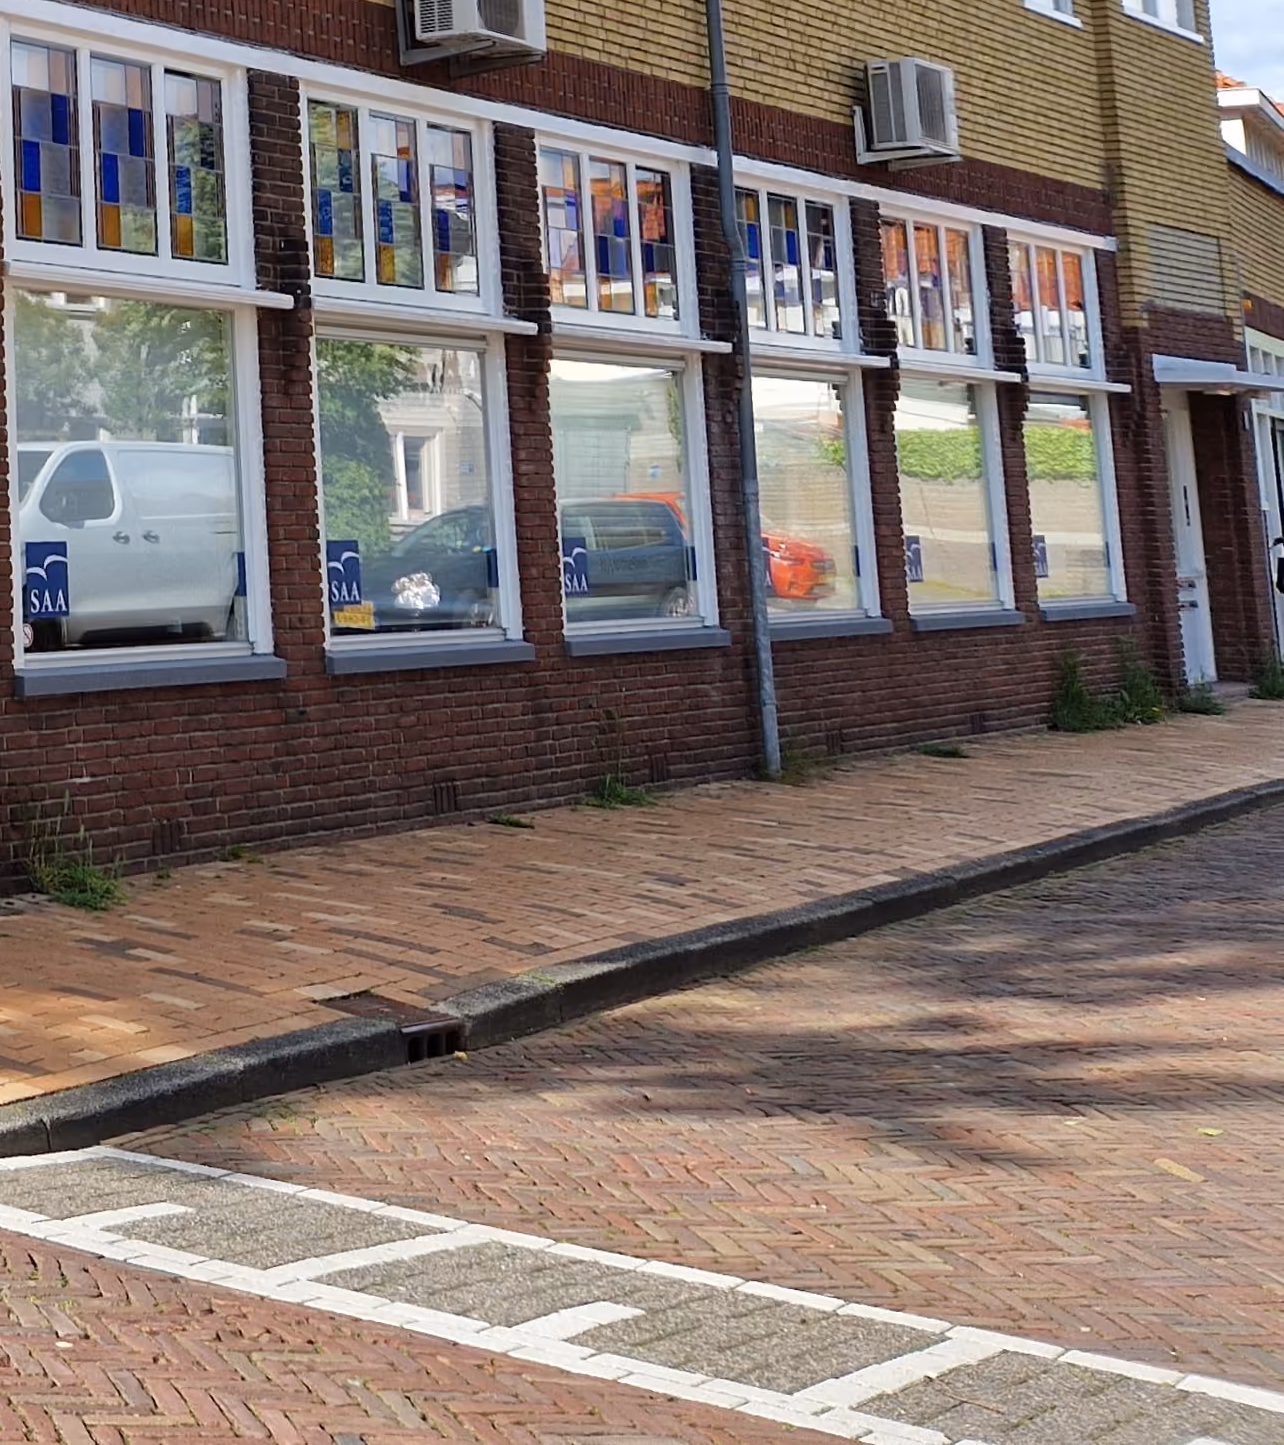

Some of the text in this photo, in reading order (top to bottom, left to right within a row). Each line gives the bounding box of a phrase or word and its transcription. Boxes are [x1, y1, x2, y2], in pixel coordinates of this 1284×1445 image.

[331, 579, 361, 602] SAA
[565, 573, 588, 593] SAA
[30, 588, 67, 613] SAA
